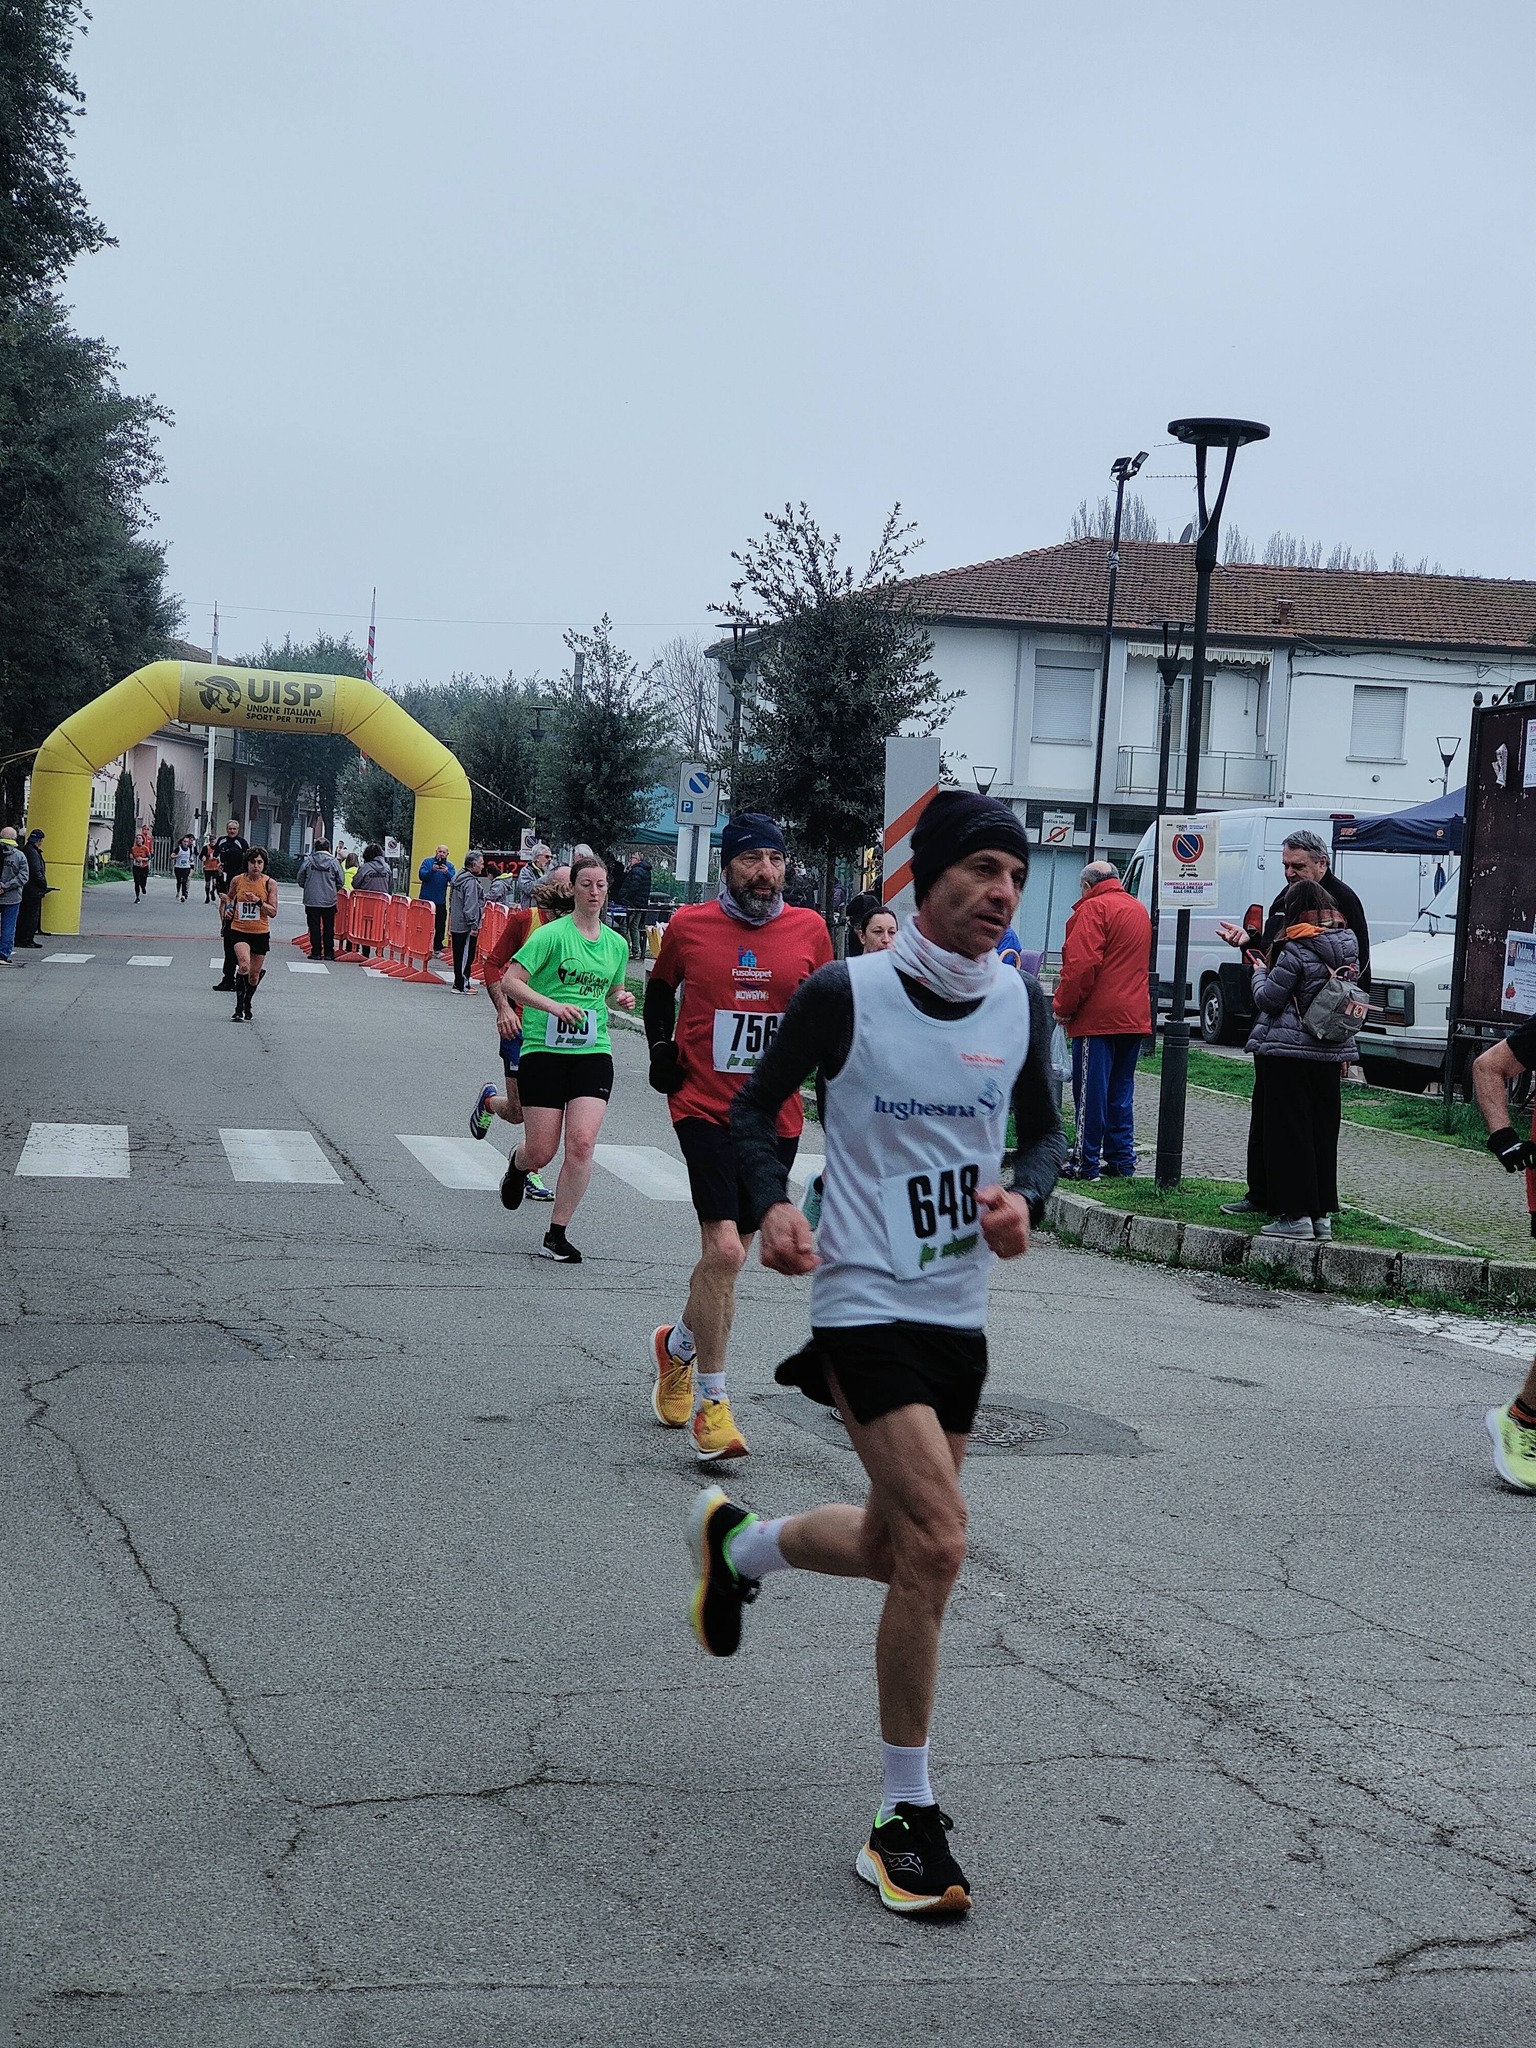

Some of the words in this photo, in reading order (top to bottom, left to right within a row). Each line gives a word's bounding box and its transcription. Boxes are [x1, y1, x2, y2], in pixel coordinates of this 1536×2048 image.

[247, 678, 323, 706] UISP
[245, 713, 275, 722] SPORT
[276, 716, 291, 724] PER
[295, 717, 317, 725] TUTTI
[246, 703, 281, 715] UNIONE
[283, 706, 322, 718] ITALIANA
[242, 903, 256, 915] 612
[730, 1013, 778, 1053] 756
[874, 1095, 976, 1121] lughesina
[907, 1164, 979, 1239] 648
